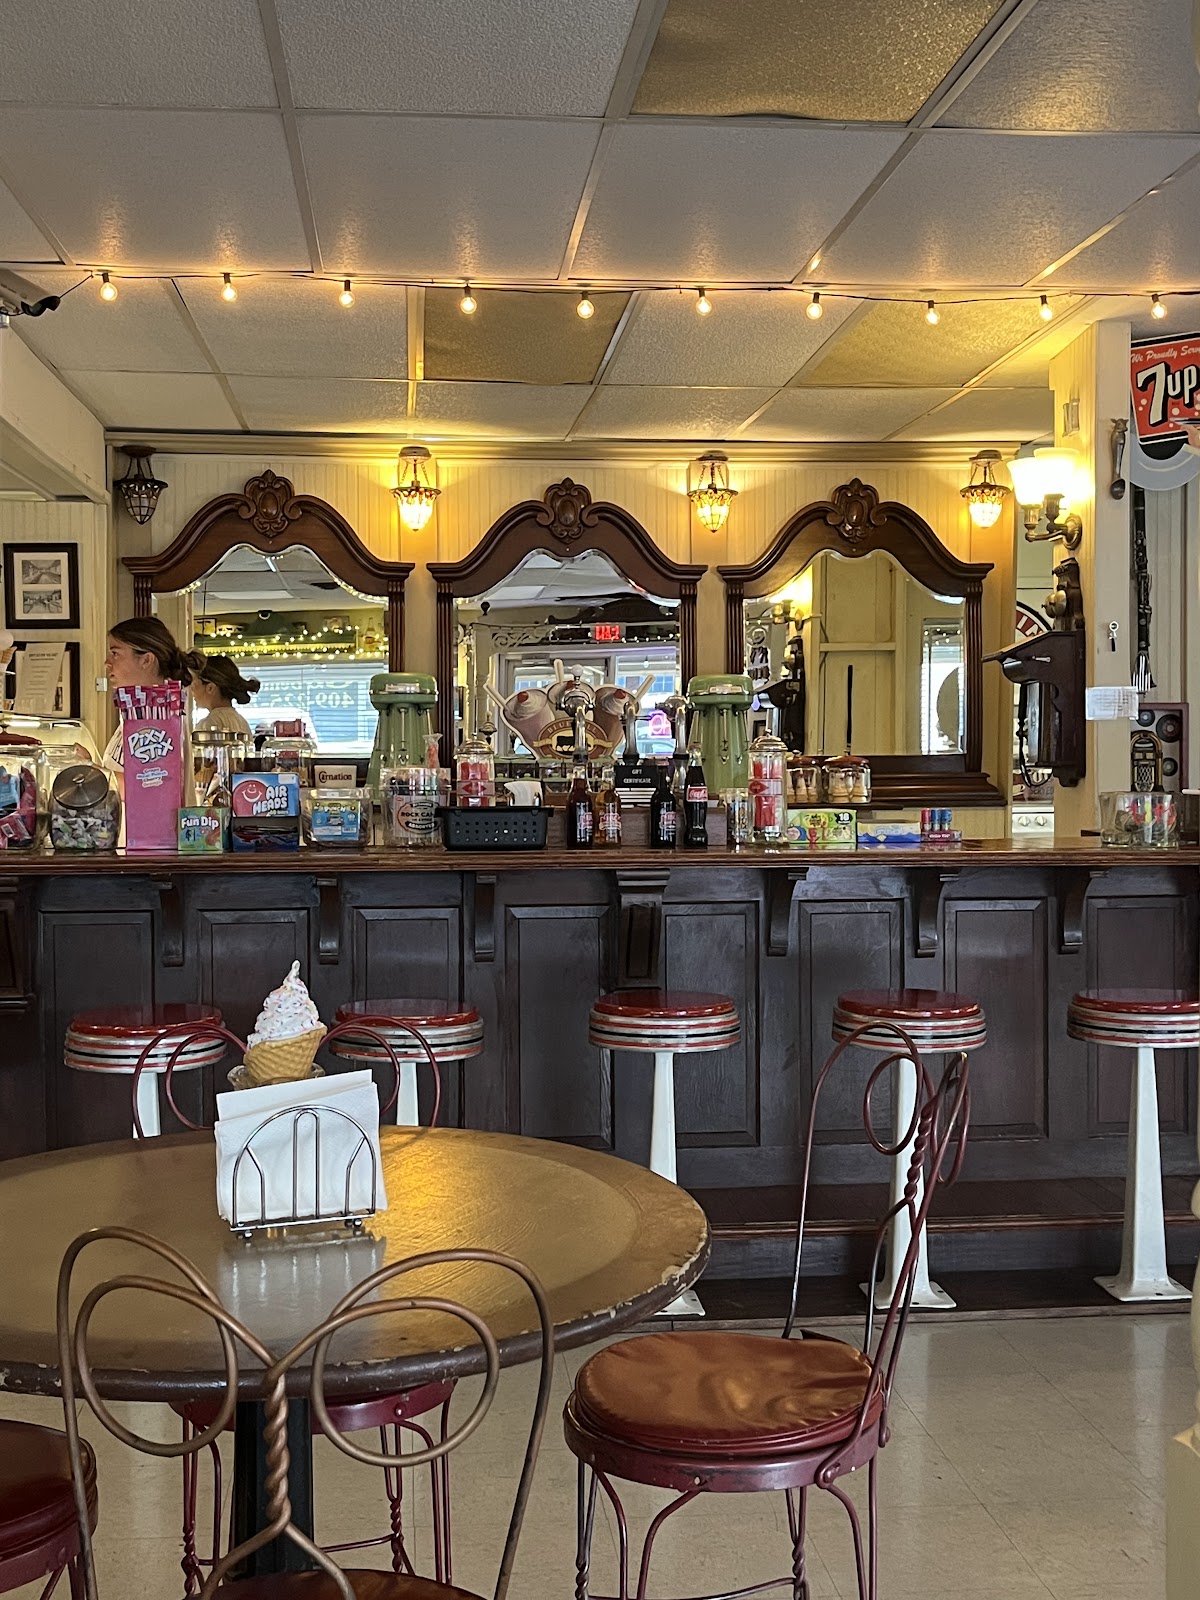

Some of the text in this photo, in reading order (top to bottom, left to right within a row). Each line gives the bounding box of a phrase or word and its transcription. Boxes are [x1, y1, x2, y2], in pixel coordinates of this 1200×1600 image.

[1131, 353, 1144, 363] We
[1145, 348, 1178, 361] Proudly
[547, 721, 571, 734] BLUE
[319, 771, 352, 783] Carnation
[266, 785, 288, 800] AIR
[252, 797, 288, 816] HEADS
[181, 816, 220, 831] Fun Dip
[185, 828, 196, 842] $1
